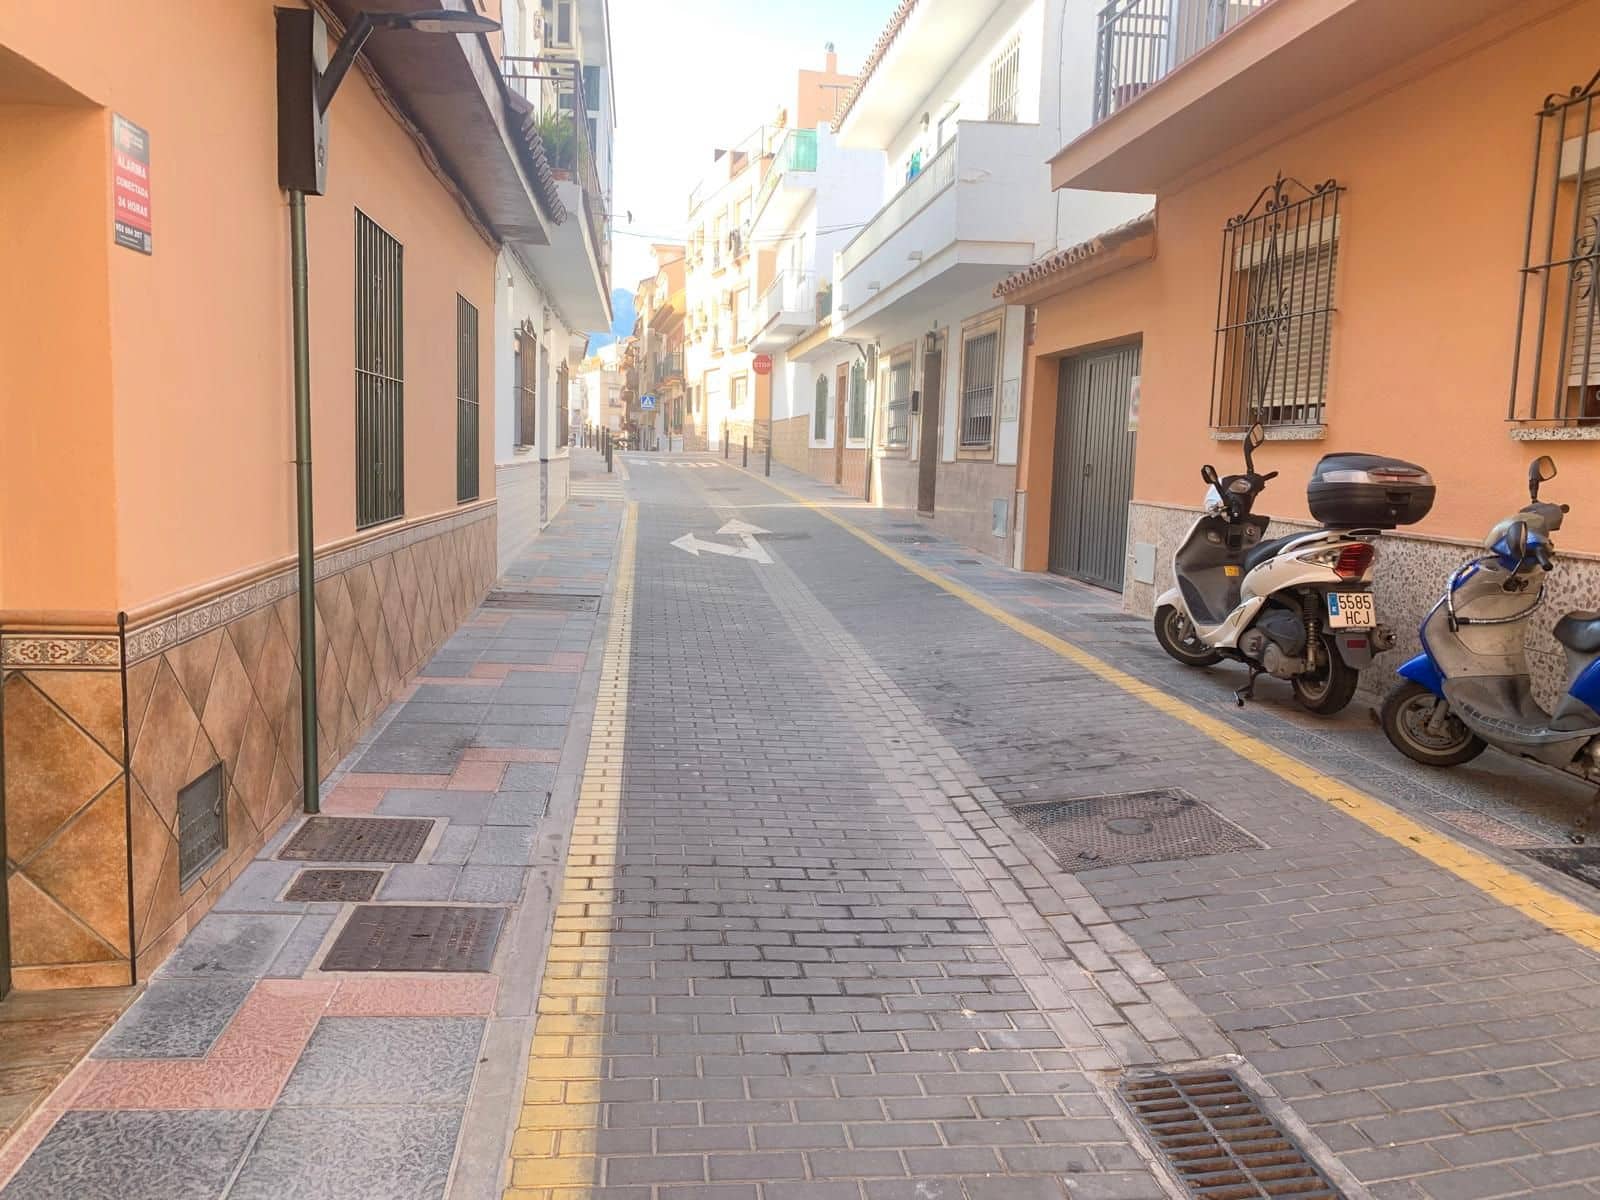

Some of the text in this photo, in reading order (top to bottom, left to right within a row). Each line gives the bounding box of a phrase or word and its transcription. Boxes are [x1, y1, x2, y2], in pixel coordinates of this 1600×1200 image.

[118, 154, 147, 179] ALARMA
[115, 176, 149, 200] CONECTADA
[118, 195, 148, 217] 24 HORAS
[1339, 595, 1371, 609] 5585
[1345, 611, 1369, 624] HCJ
